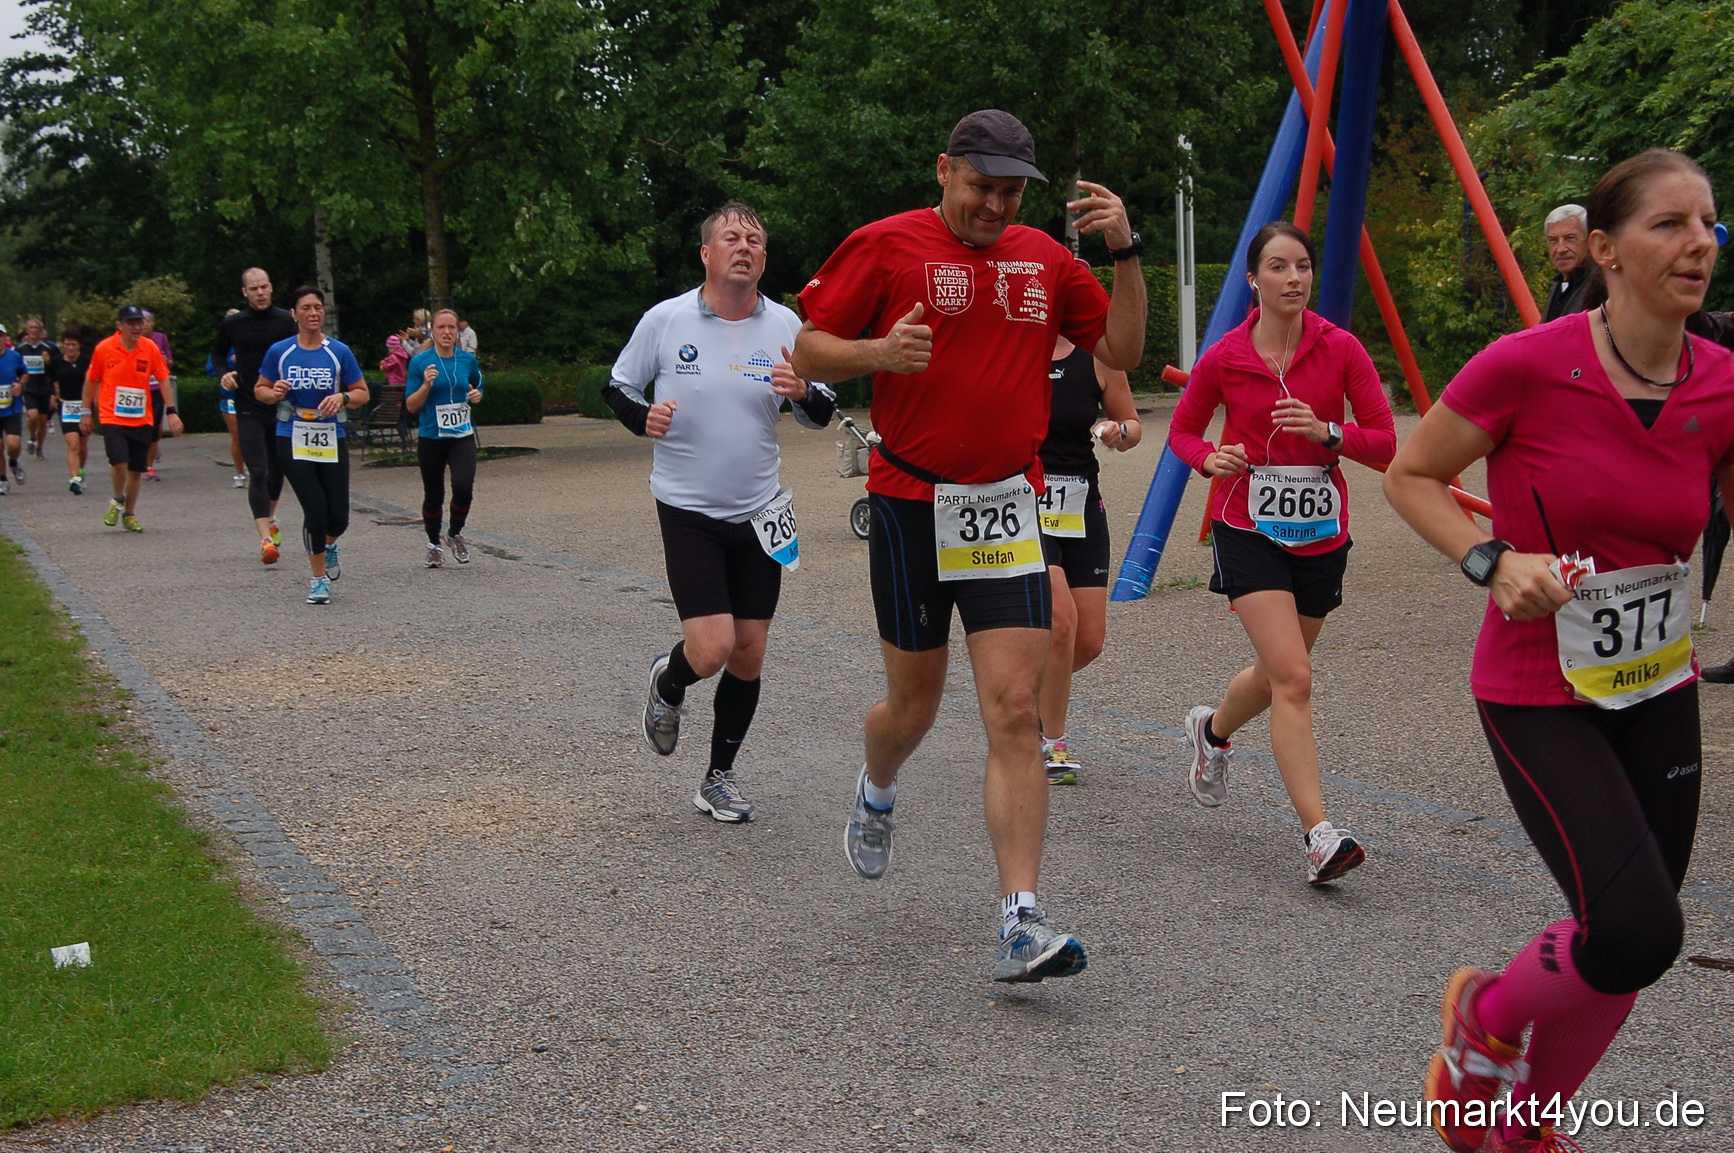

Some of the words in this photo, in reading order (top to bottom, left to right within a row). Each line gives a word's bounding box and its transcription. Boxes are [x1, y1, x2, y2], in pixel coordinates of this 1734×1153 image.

[997, 261, 1045, 271] NEUMARKTER
[997, 267, 1038, 276] STADTLAUF
[934, 269, 968, 277] IMMER
[933, 277, 969, 286] WIEDER
[936, 285, 968, 297] NEU
[936, 298, 968, 306] MARKT
[287, 365, 332, 378] Fitness
[118, 394, 144, 406] 2671
[441, 409, 468, 427] 2017
[302, 431, 329, 447] 143
[1044, 475, 1077, 483] Neumarkt
[1252, 473, 1283, 483] PARTL
[937, 494, 975, 505] PARTL
[977, 487, 1021, 504] Neumarkt
[1258, 486, 1333, 518] 2663
[752, 508, 777, 523] PARTL
[959, 501, 1021, 542] 326
[1044, 516, 1060, 528] Eva
[763, 503, 797, 549] 268
[1272, 525, 1317, 538] Sabrina
[971, 550, 1015, 565] Stefan
[1572, 588, 1612, 601] ARTL
[1614, 570, 1679, 597] Neumarkt
[1592, 588, 1672, 659] 377
[1612, 661, 1660, 690] Anika
[1680, 762, 1698, 775] asics
